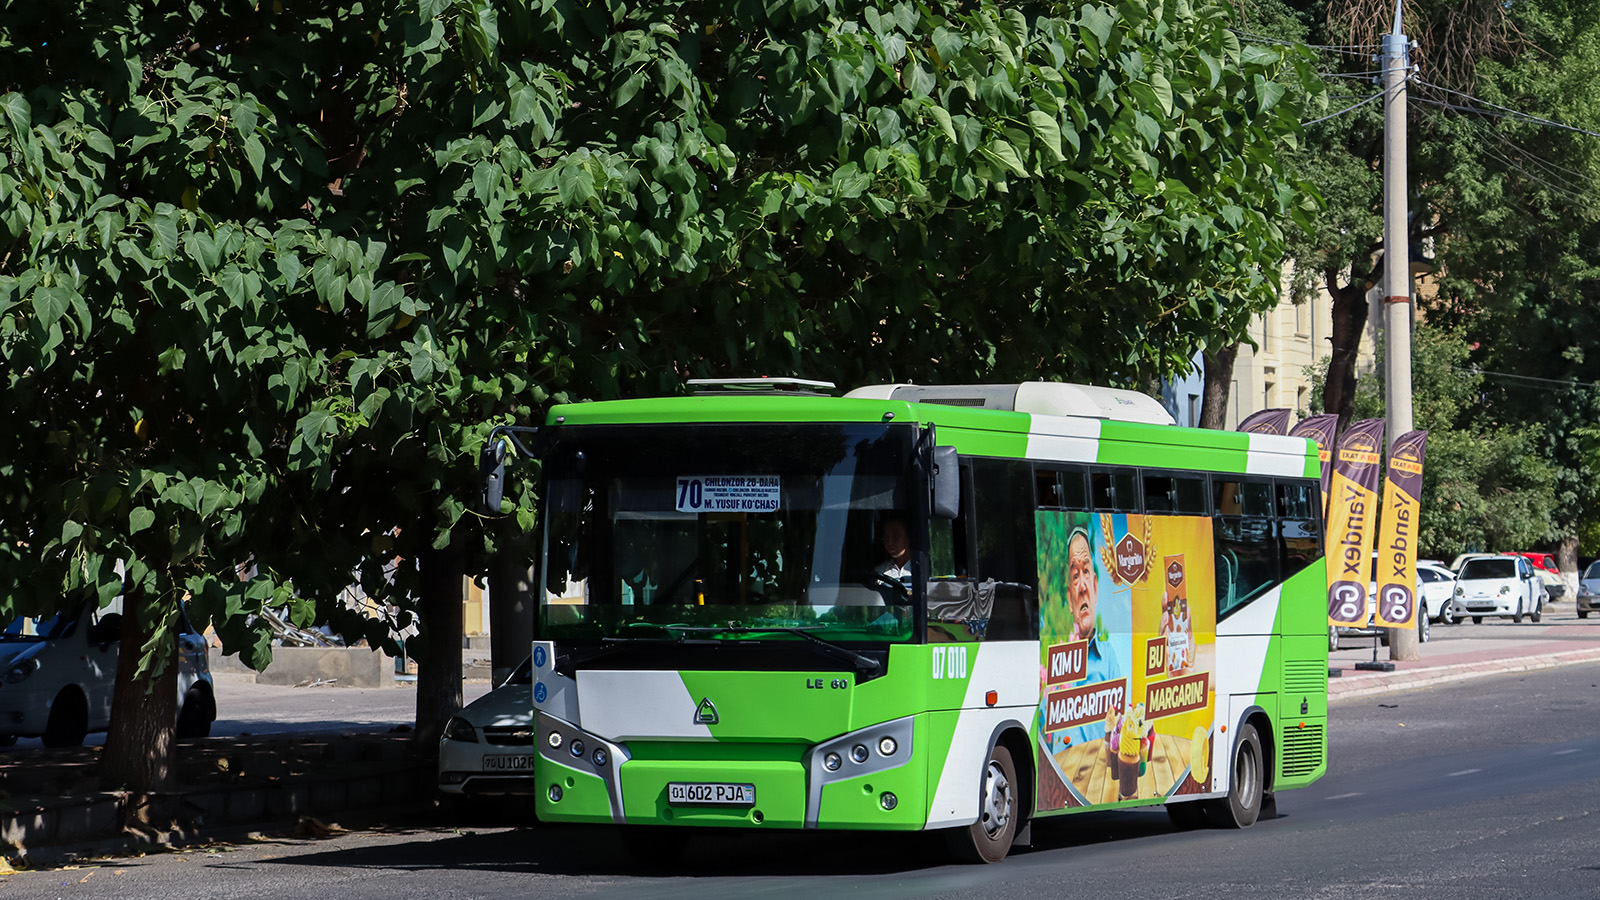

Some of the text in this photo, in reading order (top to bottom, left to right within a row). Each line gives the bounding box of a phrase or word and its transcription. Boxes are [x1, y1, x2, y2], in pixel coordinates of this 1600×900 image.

[678, 479, 702, 509] 70
[705, 477, 779, 487] CHILONZOR 20-DAHA
[704, 499, 715, 509] M.
[716, 499, 741, 509] YUSUF
[932, 646, 967, 680] 07 010
[1051, 648, 1083, 678] KIM U
[1148, 644, 1164, 669] BU
[806, 678, 848, 689] LE 60
[1148, 680, 1204, 713] MARGARIN!
[1048, 685, 1124, 726] MARGARITTO?
[672, 785, 744, 801] 01 602 PJA
